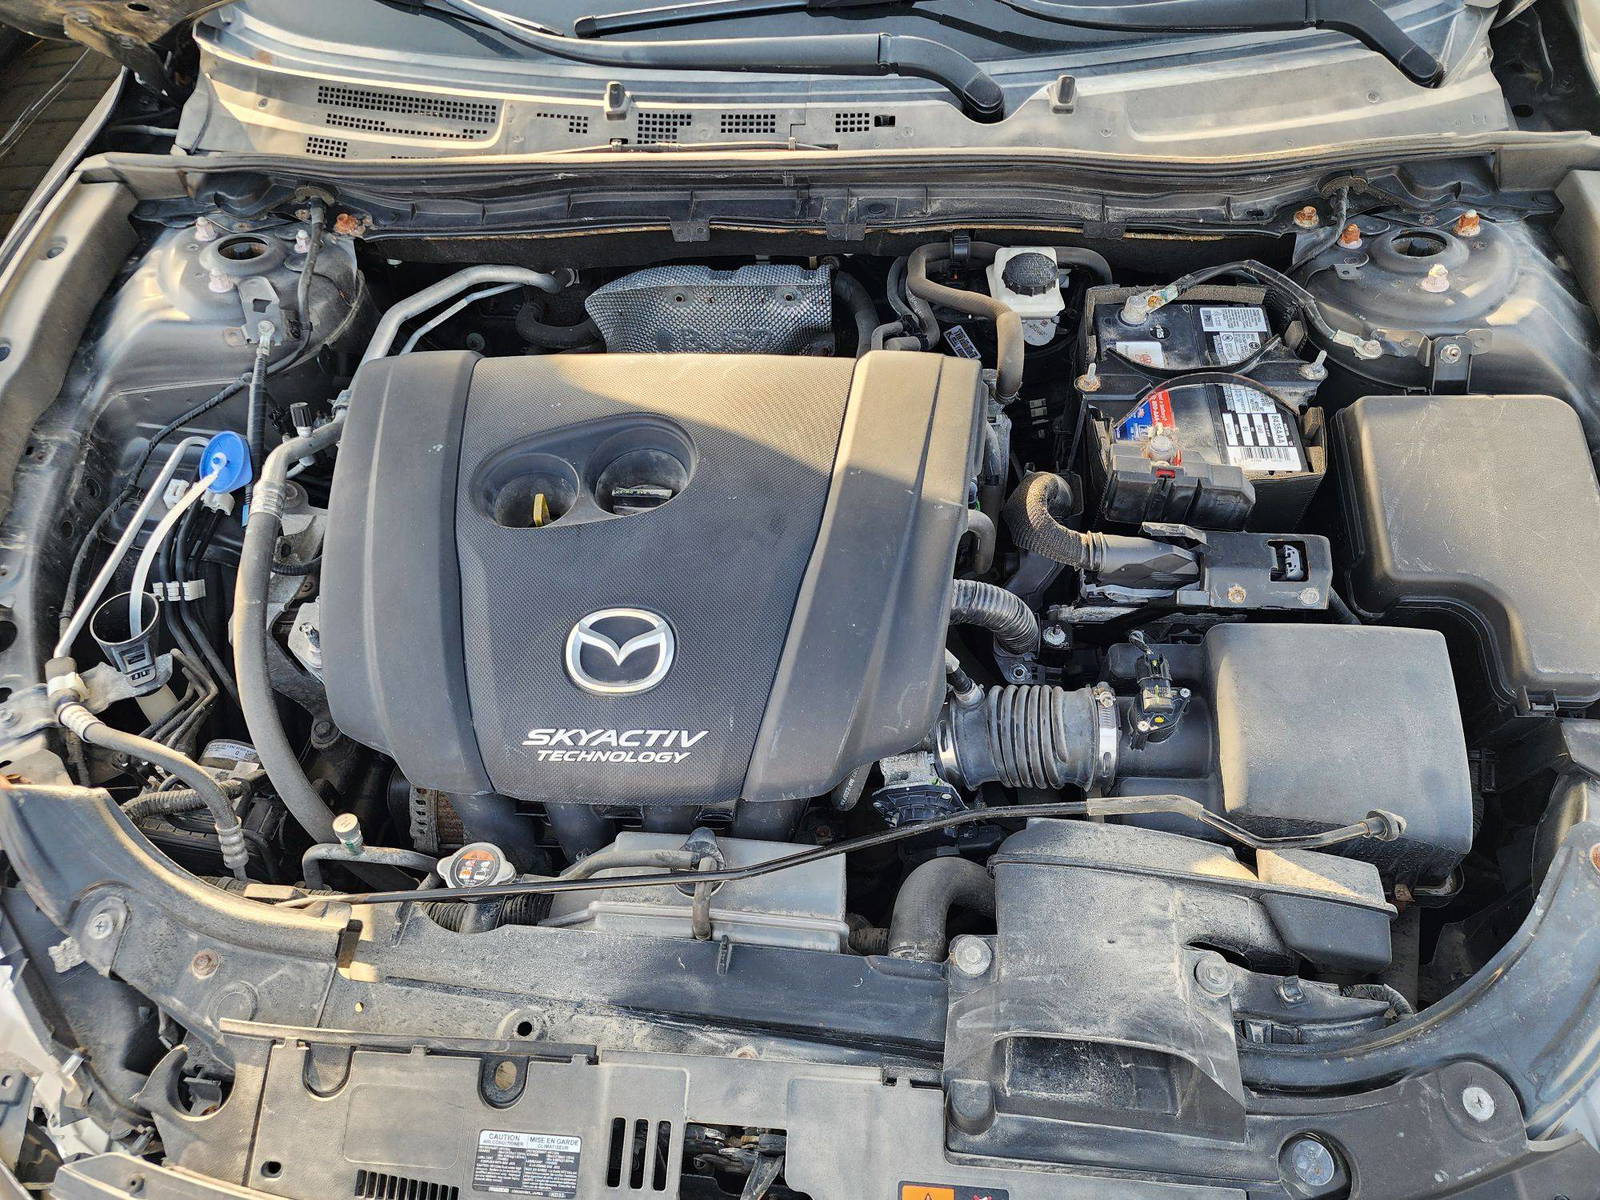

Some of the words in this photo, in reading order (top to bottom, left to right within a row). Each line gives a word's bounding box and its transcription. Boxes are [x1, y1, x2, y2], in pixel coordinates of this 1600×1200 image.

[522, 728, 709, 747] SKYACTIV
[537, 750, 692, 764] TECHNOLOGY
[488, 1133, 521, 1141] CAUTION
[529, 1136, 546, 1144] MISE
[556, 1139, 580, 1147] GARDE
